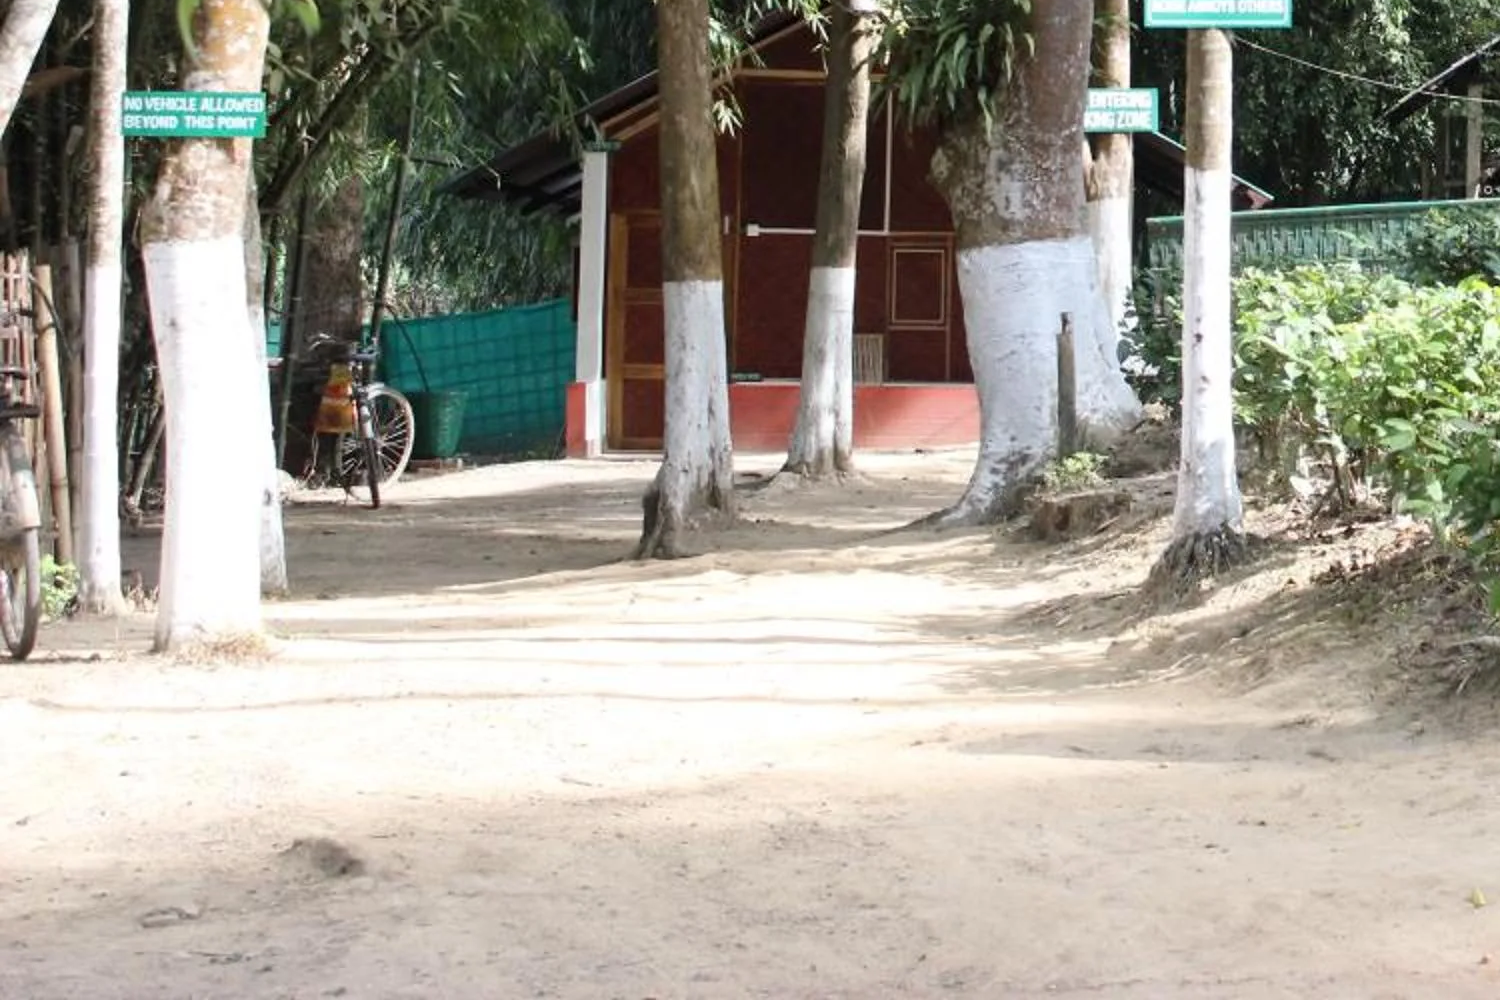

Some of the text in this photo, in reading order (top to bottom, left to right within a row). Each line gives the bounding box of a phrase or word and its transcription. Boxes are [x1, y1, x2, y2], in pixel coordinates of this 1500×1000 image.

[124, 96, 264, 113] NO VEHICLE ALLOWED
[124, 115, 257, 129] BEYOND THIS POINT
[1117, 111, 1152, 130] ZONE
